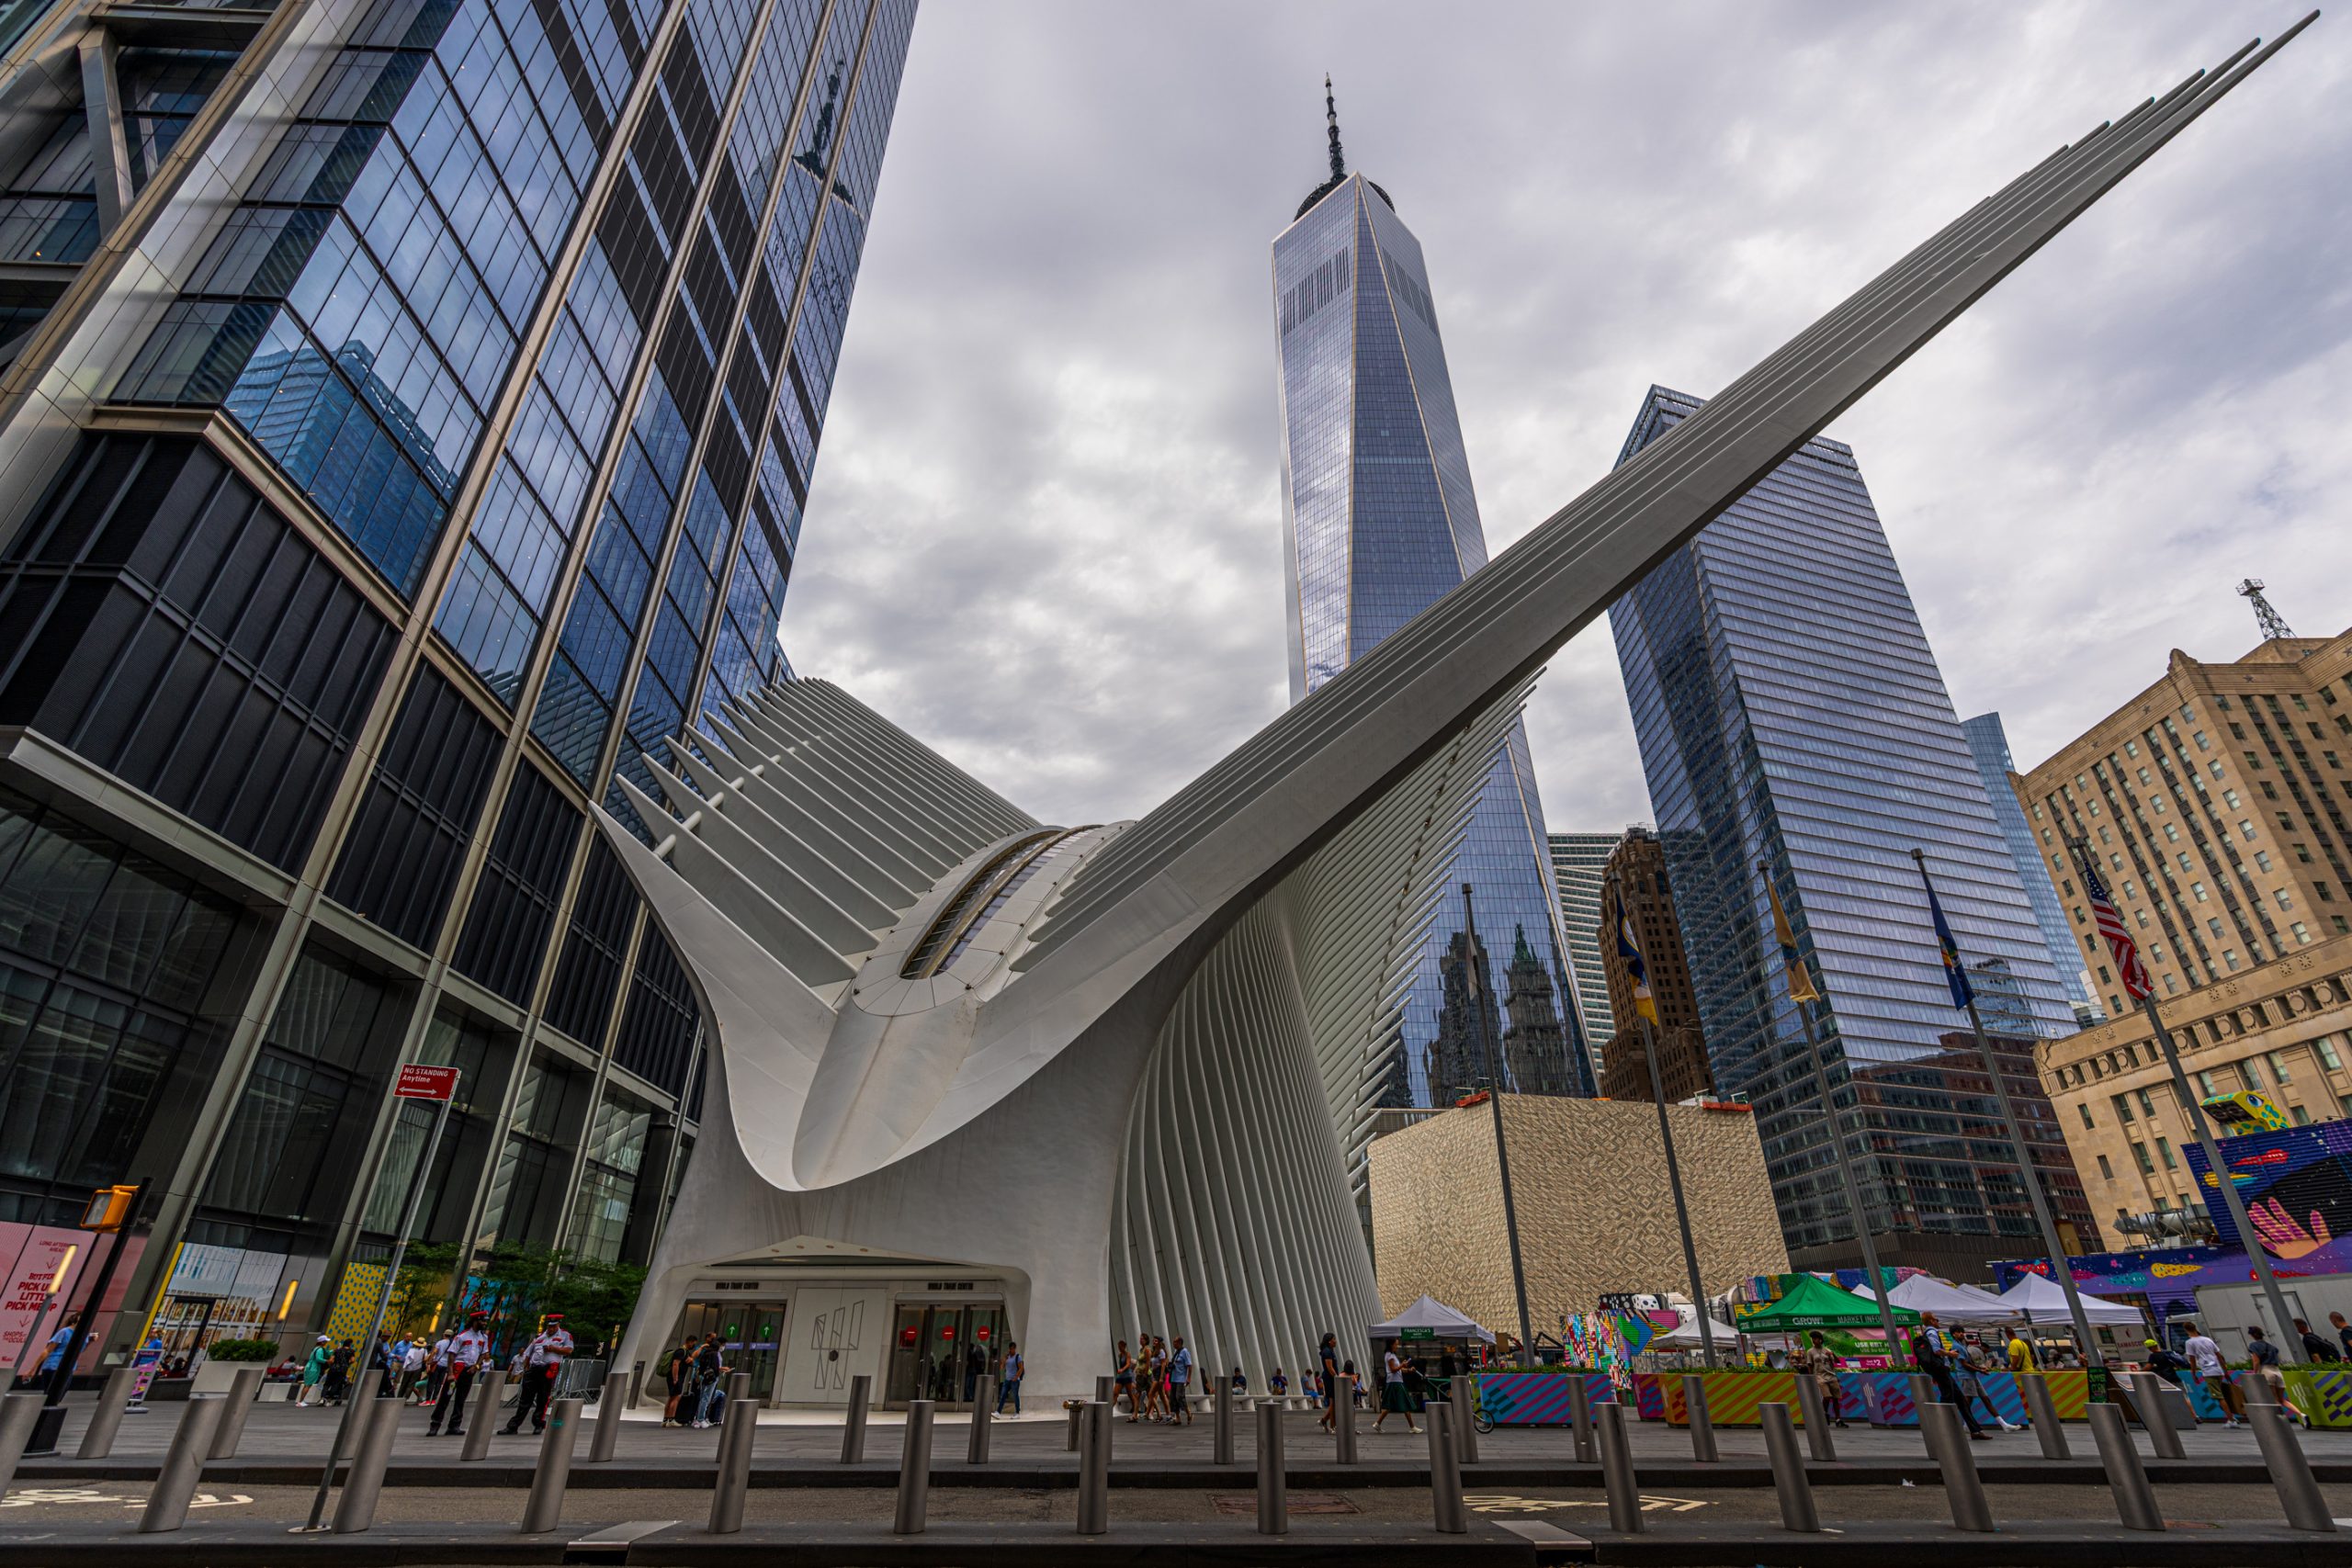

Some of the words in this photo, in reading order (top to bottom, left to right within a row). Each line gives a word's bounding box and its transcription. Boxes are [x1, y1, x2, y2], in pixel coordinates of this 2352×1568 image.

[415, 1068, 448, 1077] STANDING
[402, 1075, 431, 1083] Anytime
[17, 1281, 40, 1292] PICK
[19, 1292, 46, 1302] LITTL
[5, 1301, 28, 1310] PICK
[1838, 1315, 1863, 1324] MARKET
